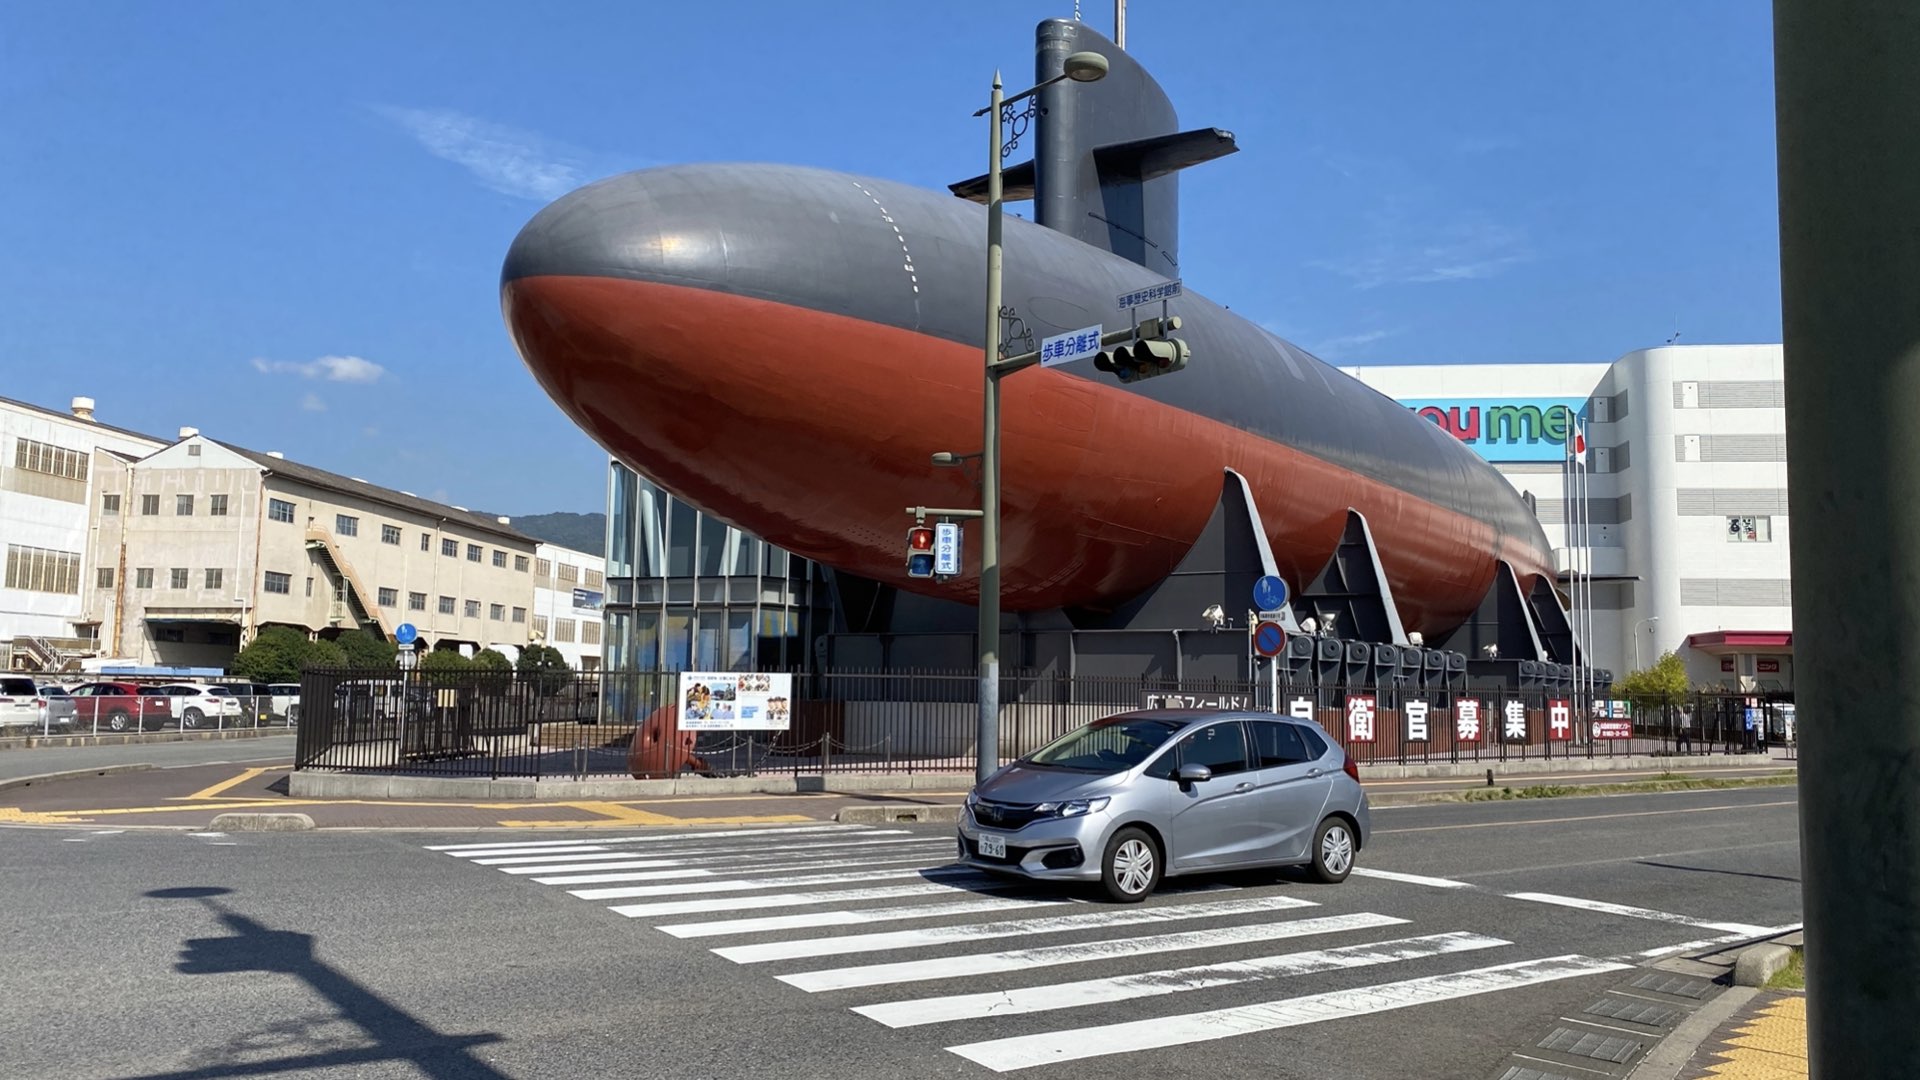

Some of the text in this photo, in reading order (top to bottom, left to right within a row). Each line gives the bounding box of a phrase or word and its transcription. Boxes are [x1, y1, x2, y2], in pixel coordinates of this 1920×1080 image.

[1119, 282, 1180, 309] 海事歴史科学館前
[1043, 331, 1099, 362] 歩車分離式
[1408, 406, 1480, 440] ou
[941, 528, 952, 570] 歩車分離式
[1146, 694, 1248, 711] 広フィールド！
